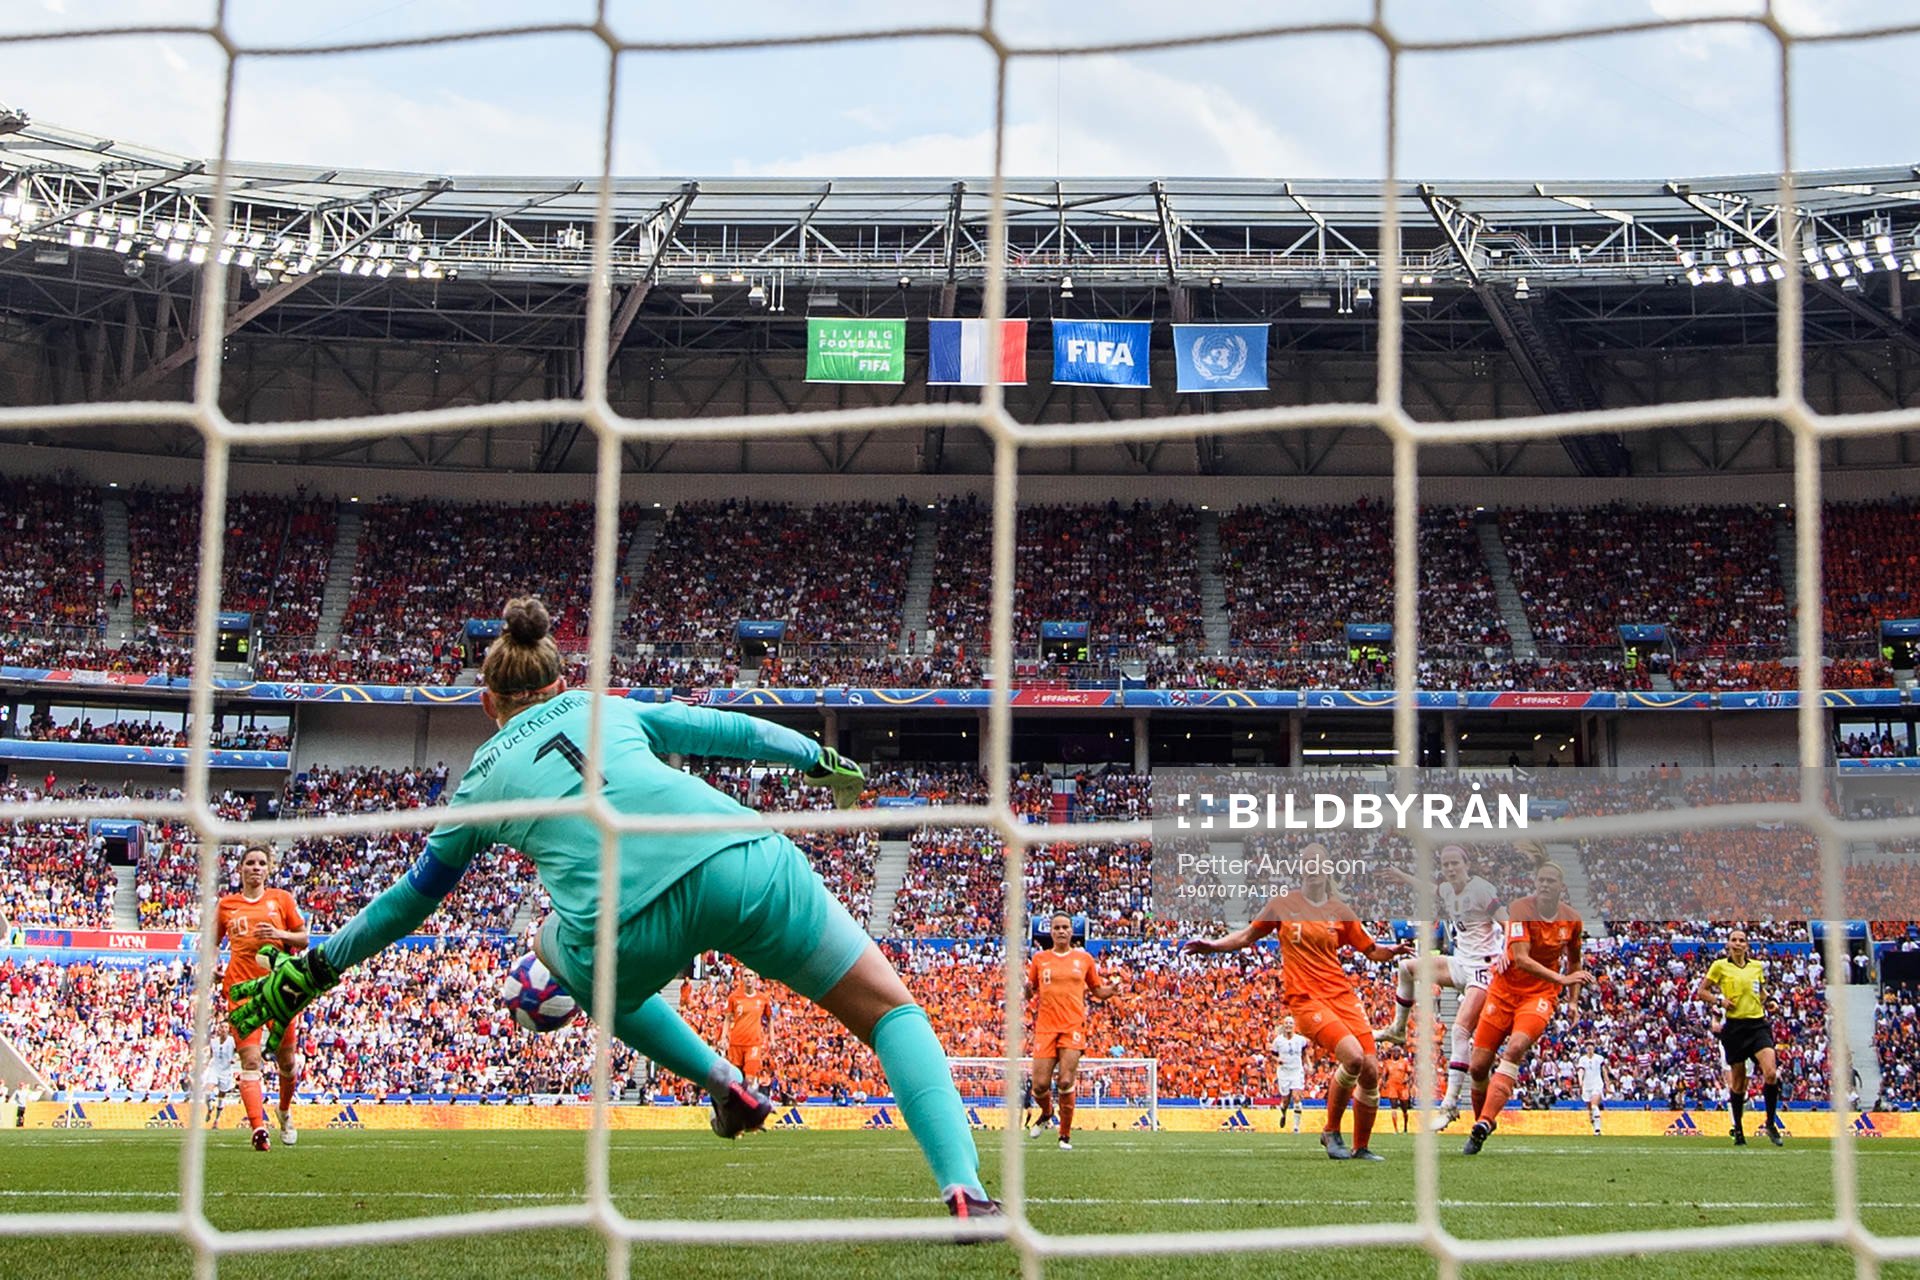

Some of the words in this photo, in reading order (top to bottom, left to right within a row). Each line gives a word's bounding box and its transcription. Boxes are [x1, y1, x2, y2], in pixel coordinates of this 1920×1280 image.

[819, 329, 892, 339] LIVING
[819, 339, 892, 349] FOOTBALL
[1067, 339, 1134, 366] FIFA
[859, 359, 890, 371] FIFA
[502, 696, 592, 750] VEENENDA
[1291, 922, 1302, 943] 3
[109, 934, 146, 949] LYON
[1475, 968, 1490, 985] 16
[51, 1119, 93, 1128] addas
